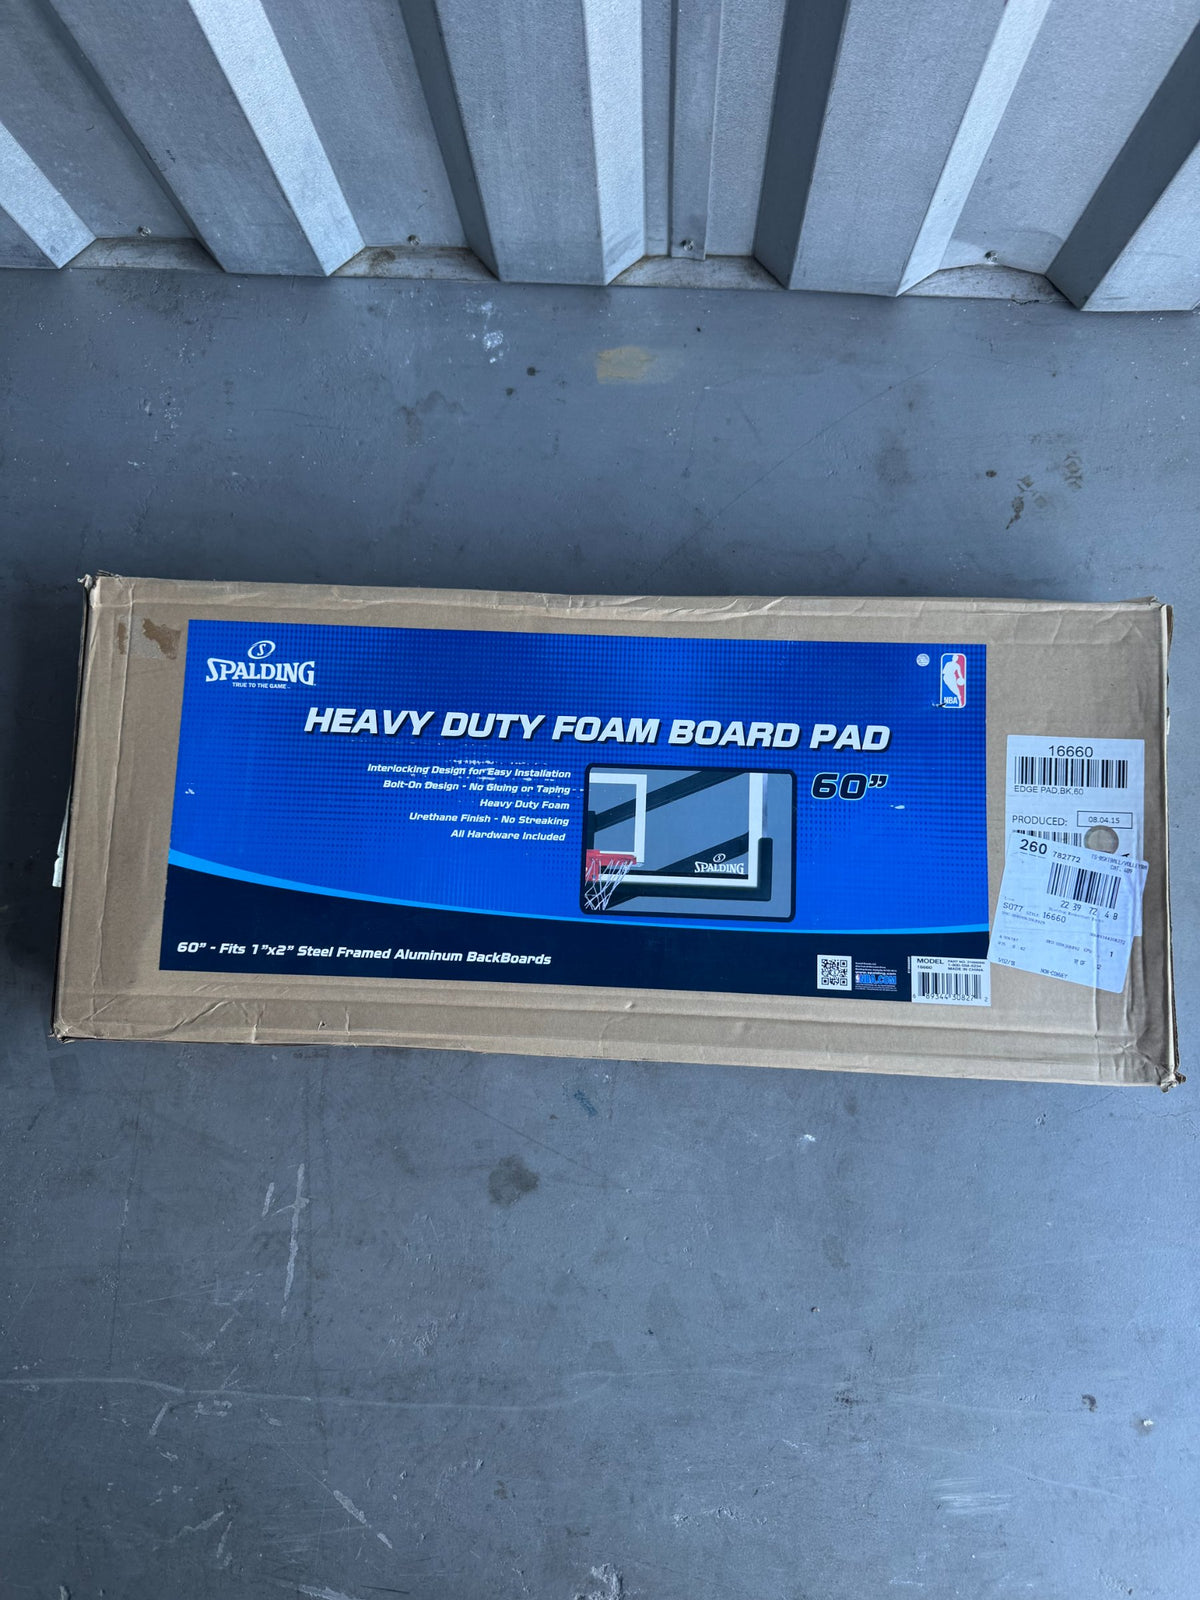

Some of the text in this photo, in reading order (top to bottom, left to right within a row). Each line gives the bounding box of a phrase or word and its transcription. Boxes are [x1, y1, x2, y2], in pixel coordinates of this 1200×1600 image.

[205, 657, 316, 686] SPALDING
[943, 696, 958, 705] NBA
[303, 706, 891, 751] HEAVY DUTY FOAM BOARD PAD
[1048, 745, 1094, 758] 16660
[367, 763, 572, 779] Interlocking Design for Easy Installation
[383, 780, 422, 790] Bolt-On
[424, 781, 459, 792] Design
[469, 783, 485, 792] No
[486, 784, 518, 794] Gluing
[520, 786, 534, 794] or
[537, 785, 571, 796] Taping
[1013, 784, 1039, 794] EDGE
[480, 798, 570, 811] Heavy Duty Foam
[409, 812, 458, 823] Urethane
[460, 813, 492, 824] Finish
[501, 815, 516, 824] No
[518, 816, 570, 827] Streaking
[1012, 814, 1120, 827] PRODUCED: 08.04.15
[450, 829, 566, 842] All Hardware Included
[1019, 838, 1081, 864] 260 782772
[694, 861, 745, 875] SPALDING
[1060, 899, 1070, 910] 22
[1072, 902, 1082, 912] 39
[1089, 906, 1099, 916] 72
[1104, 910, 1110, 919] 4
[1042, 911, 1067, 924] 16660
[219, 942, 247, 955] Fits
[297, 945, 334, 958] Steel
[336, 946, 392, 960] Framed
[394, 948, 463, 963] Aluminum
[466, 951, 552, 965] BackBoards
